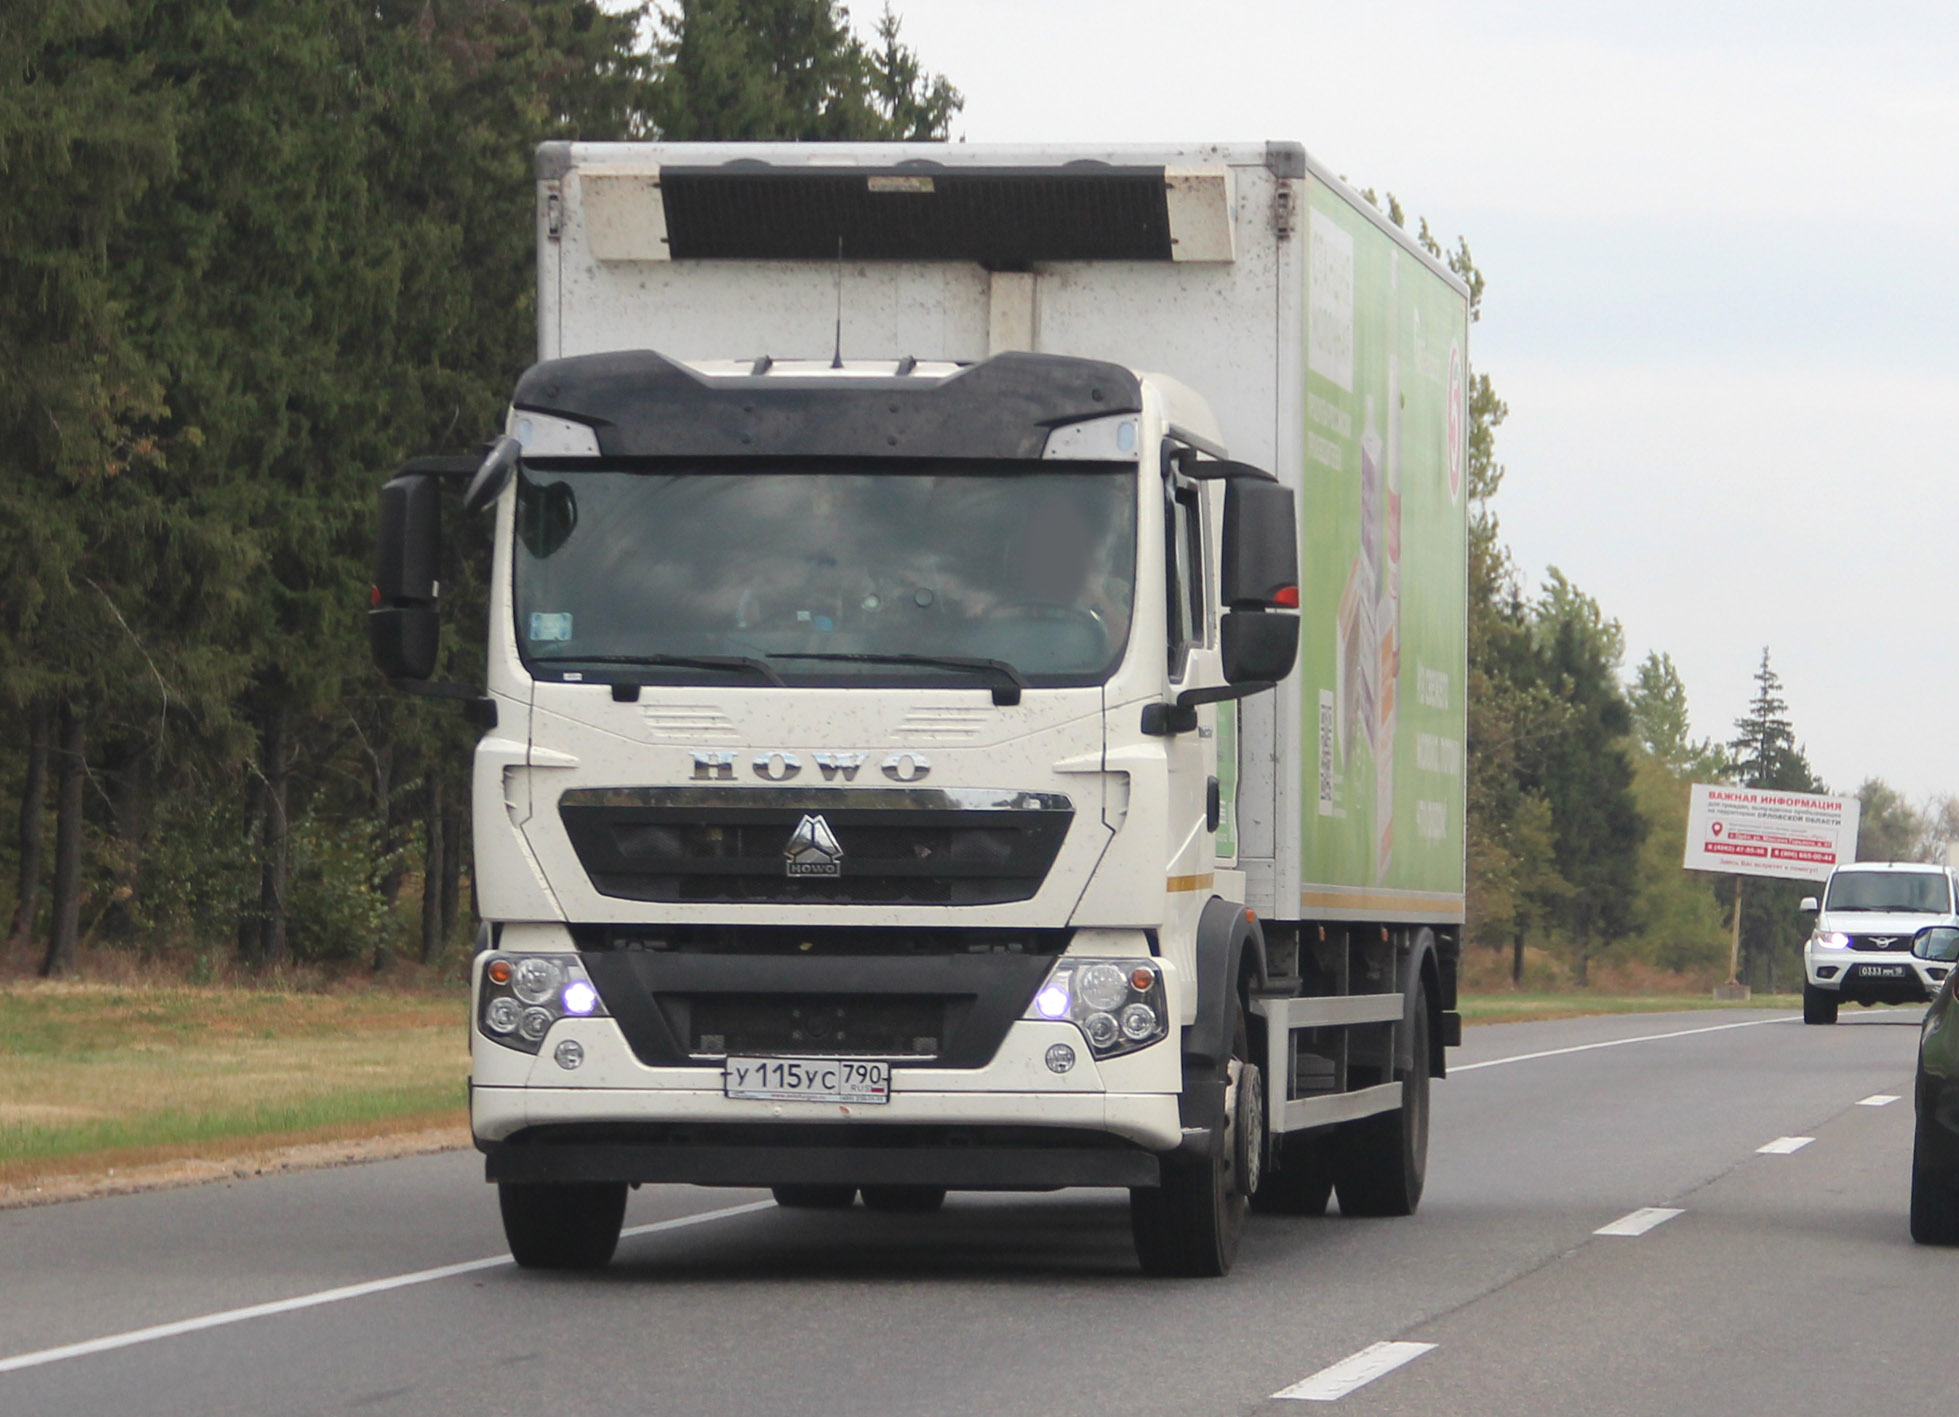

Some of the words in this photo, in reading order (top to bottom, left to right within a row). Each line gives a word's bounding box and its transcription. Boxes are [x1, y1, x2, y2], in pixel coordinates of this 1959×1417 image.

[689, 751, 932, 783] HOWO
[1708, 791, 1757, 804] ВАЖНАЯ
[1761, 796, 1842, 811] ИНФОРМАЦИЯ
[1757, 812, 1803, 822] ОРЛОВСКОЙ
[1805, 817, 1841, 825] ОБЛАСТИ
[791, 864, 836, 874] HOWO
[843, 1064, 881, 1084] 790
[851, 1084, 872, 1092] RUS
